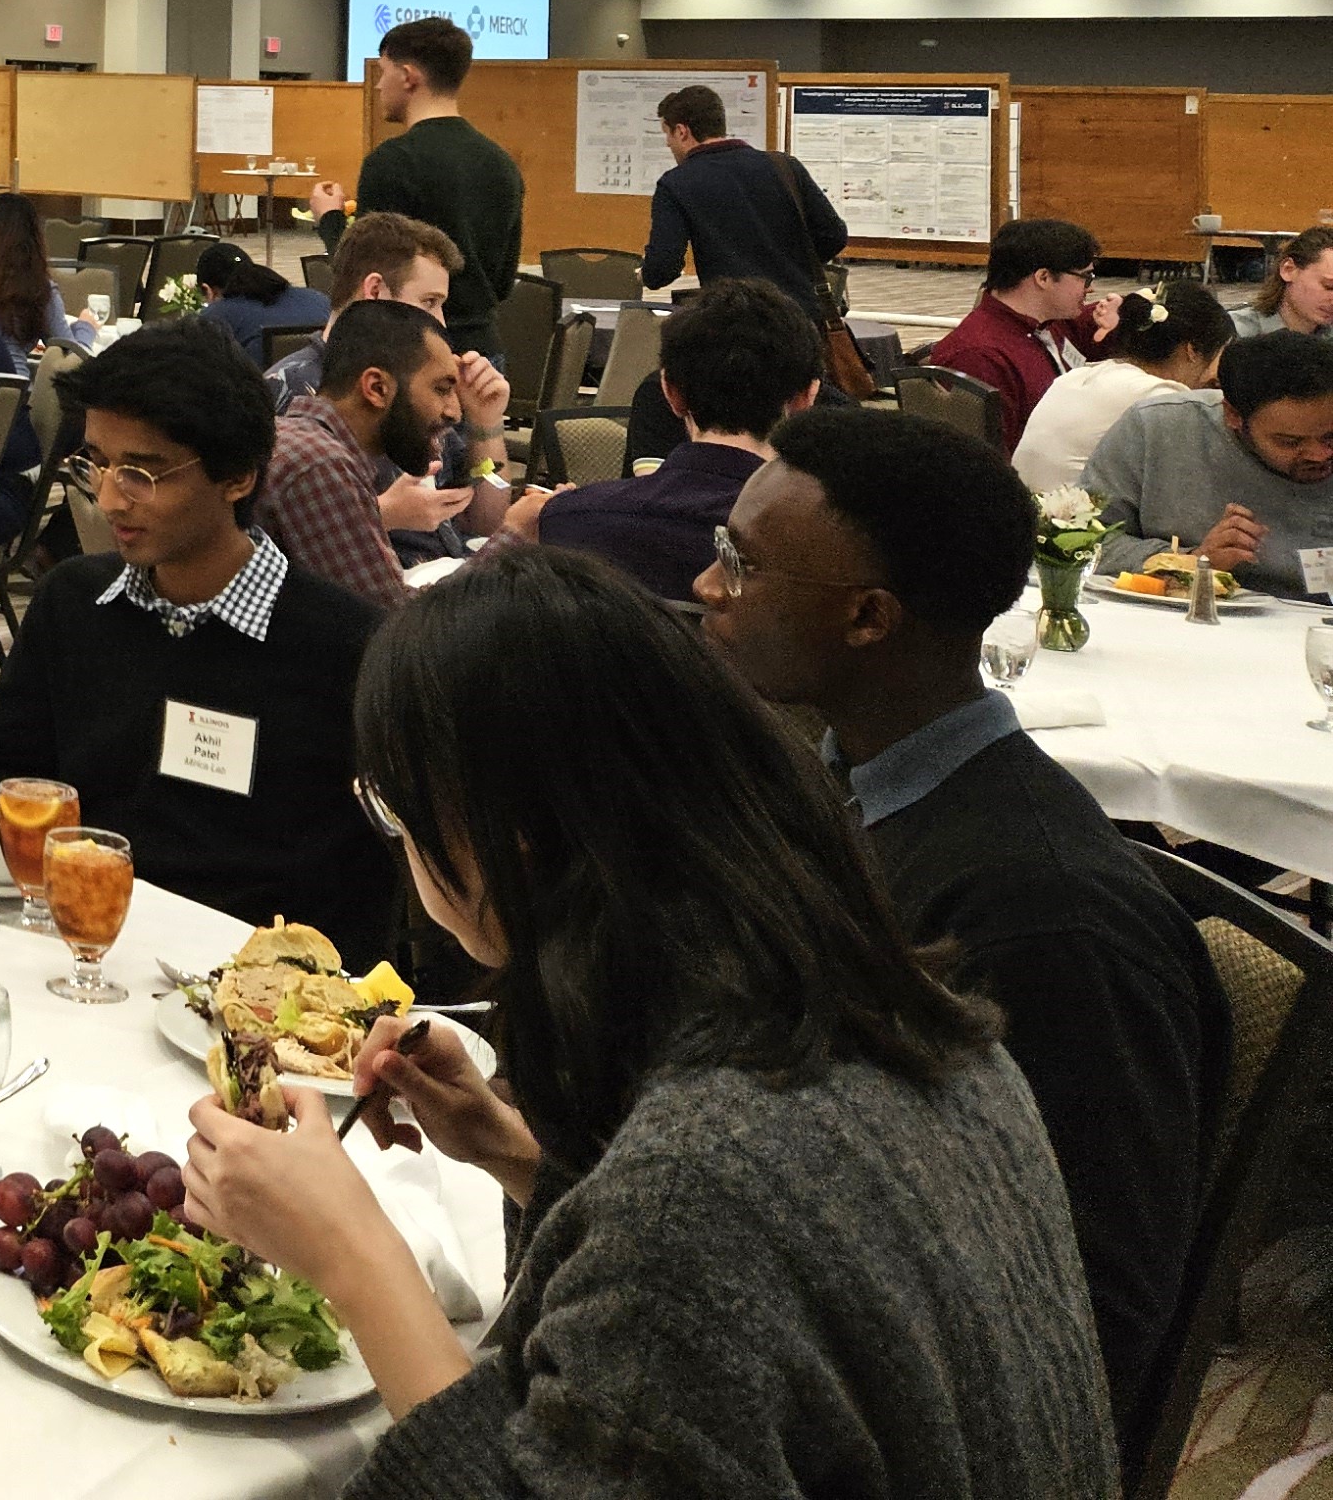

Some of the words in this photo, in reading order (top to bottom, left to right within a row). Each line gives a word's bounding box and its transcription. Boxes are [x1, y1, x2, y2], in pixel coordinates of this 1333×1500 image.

[489, 15, 528, 36] MERCK
[195, 732, 222, 747] Akhil
[194, 745, 220, 761] Patel
